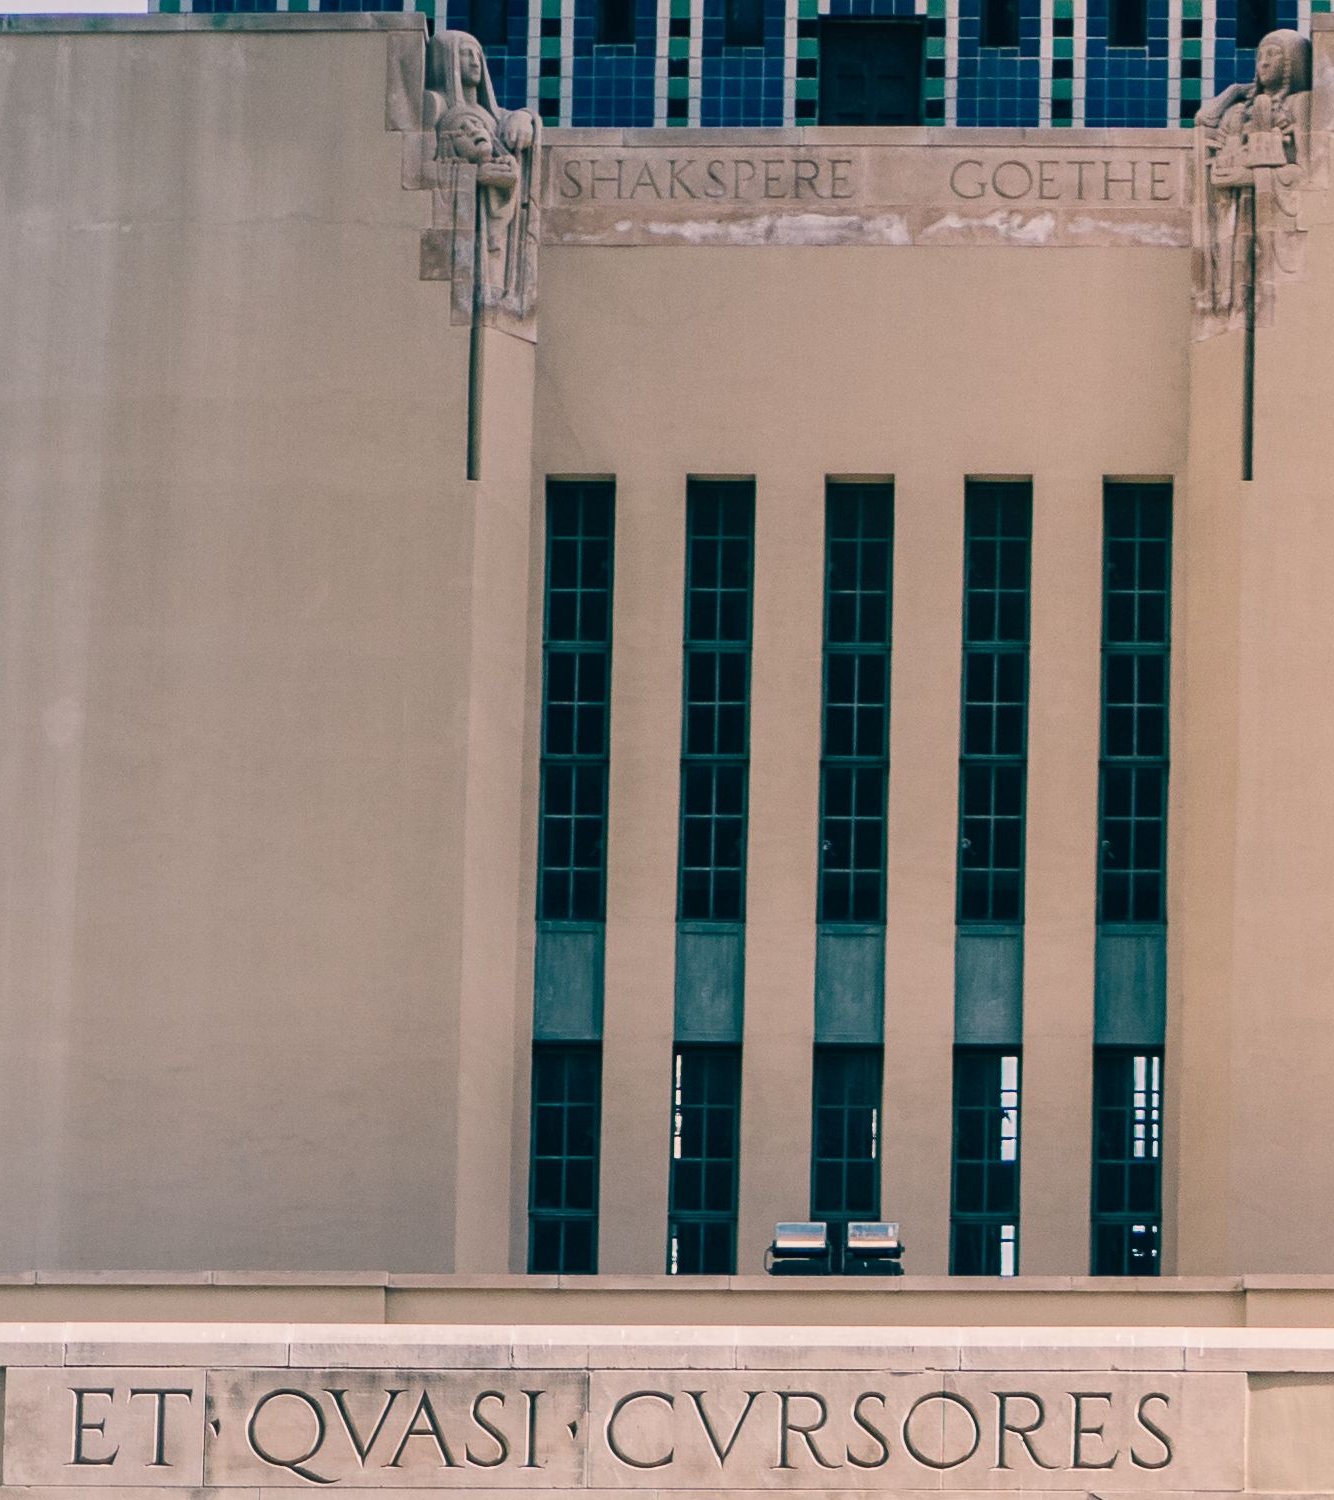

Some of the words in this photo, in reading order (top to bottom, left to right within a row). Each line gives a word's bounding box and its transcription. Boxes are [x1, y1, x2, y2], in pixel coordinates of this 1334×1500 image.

[559, 158, 856, 200] SHAKSPERE
[949, 160, 1175, 202] GOETHE
[66, 1386, 193, 1468] ET
[244, 1387, 548, 1486] QVASI
[605, 1389, 1176, 1471] CVRSORES
